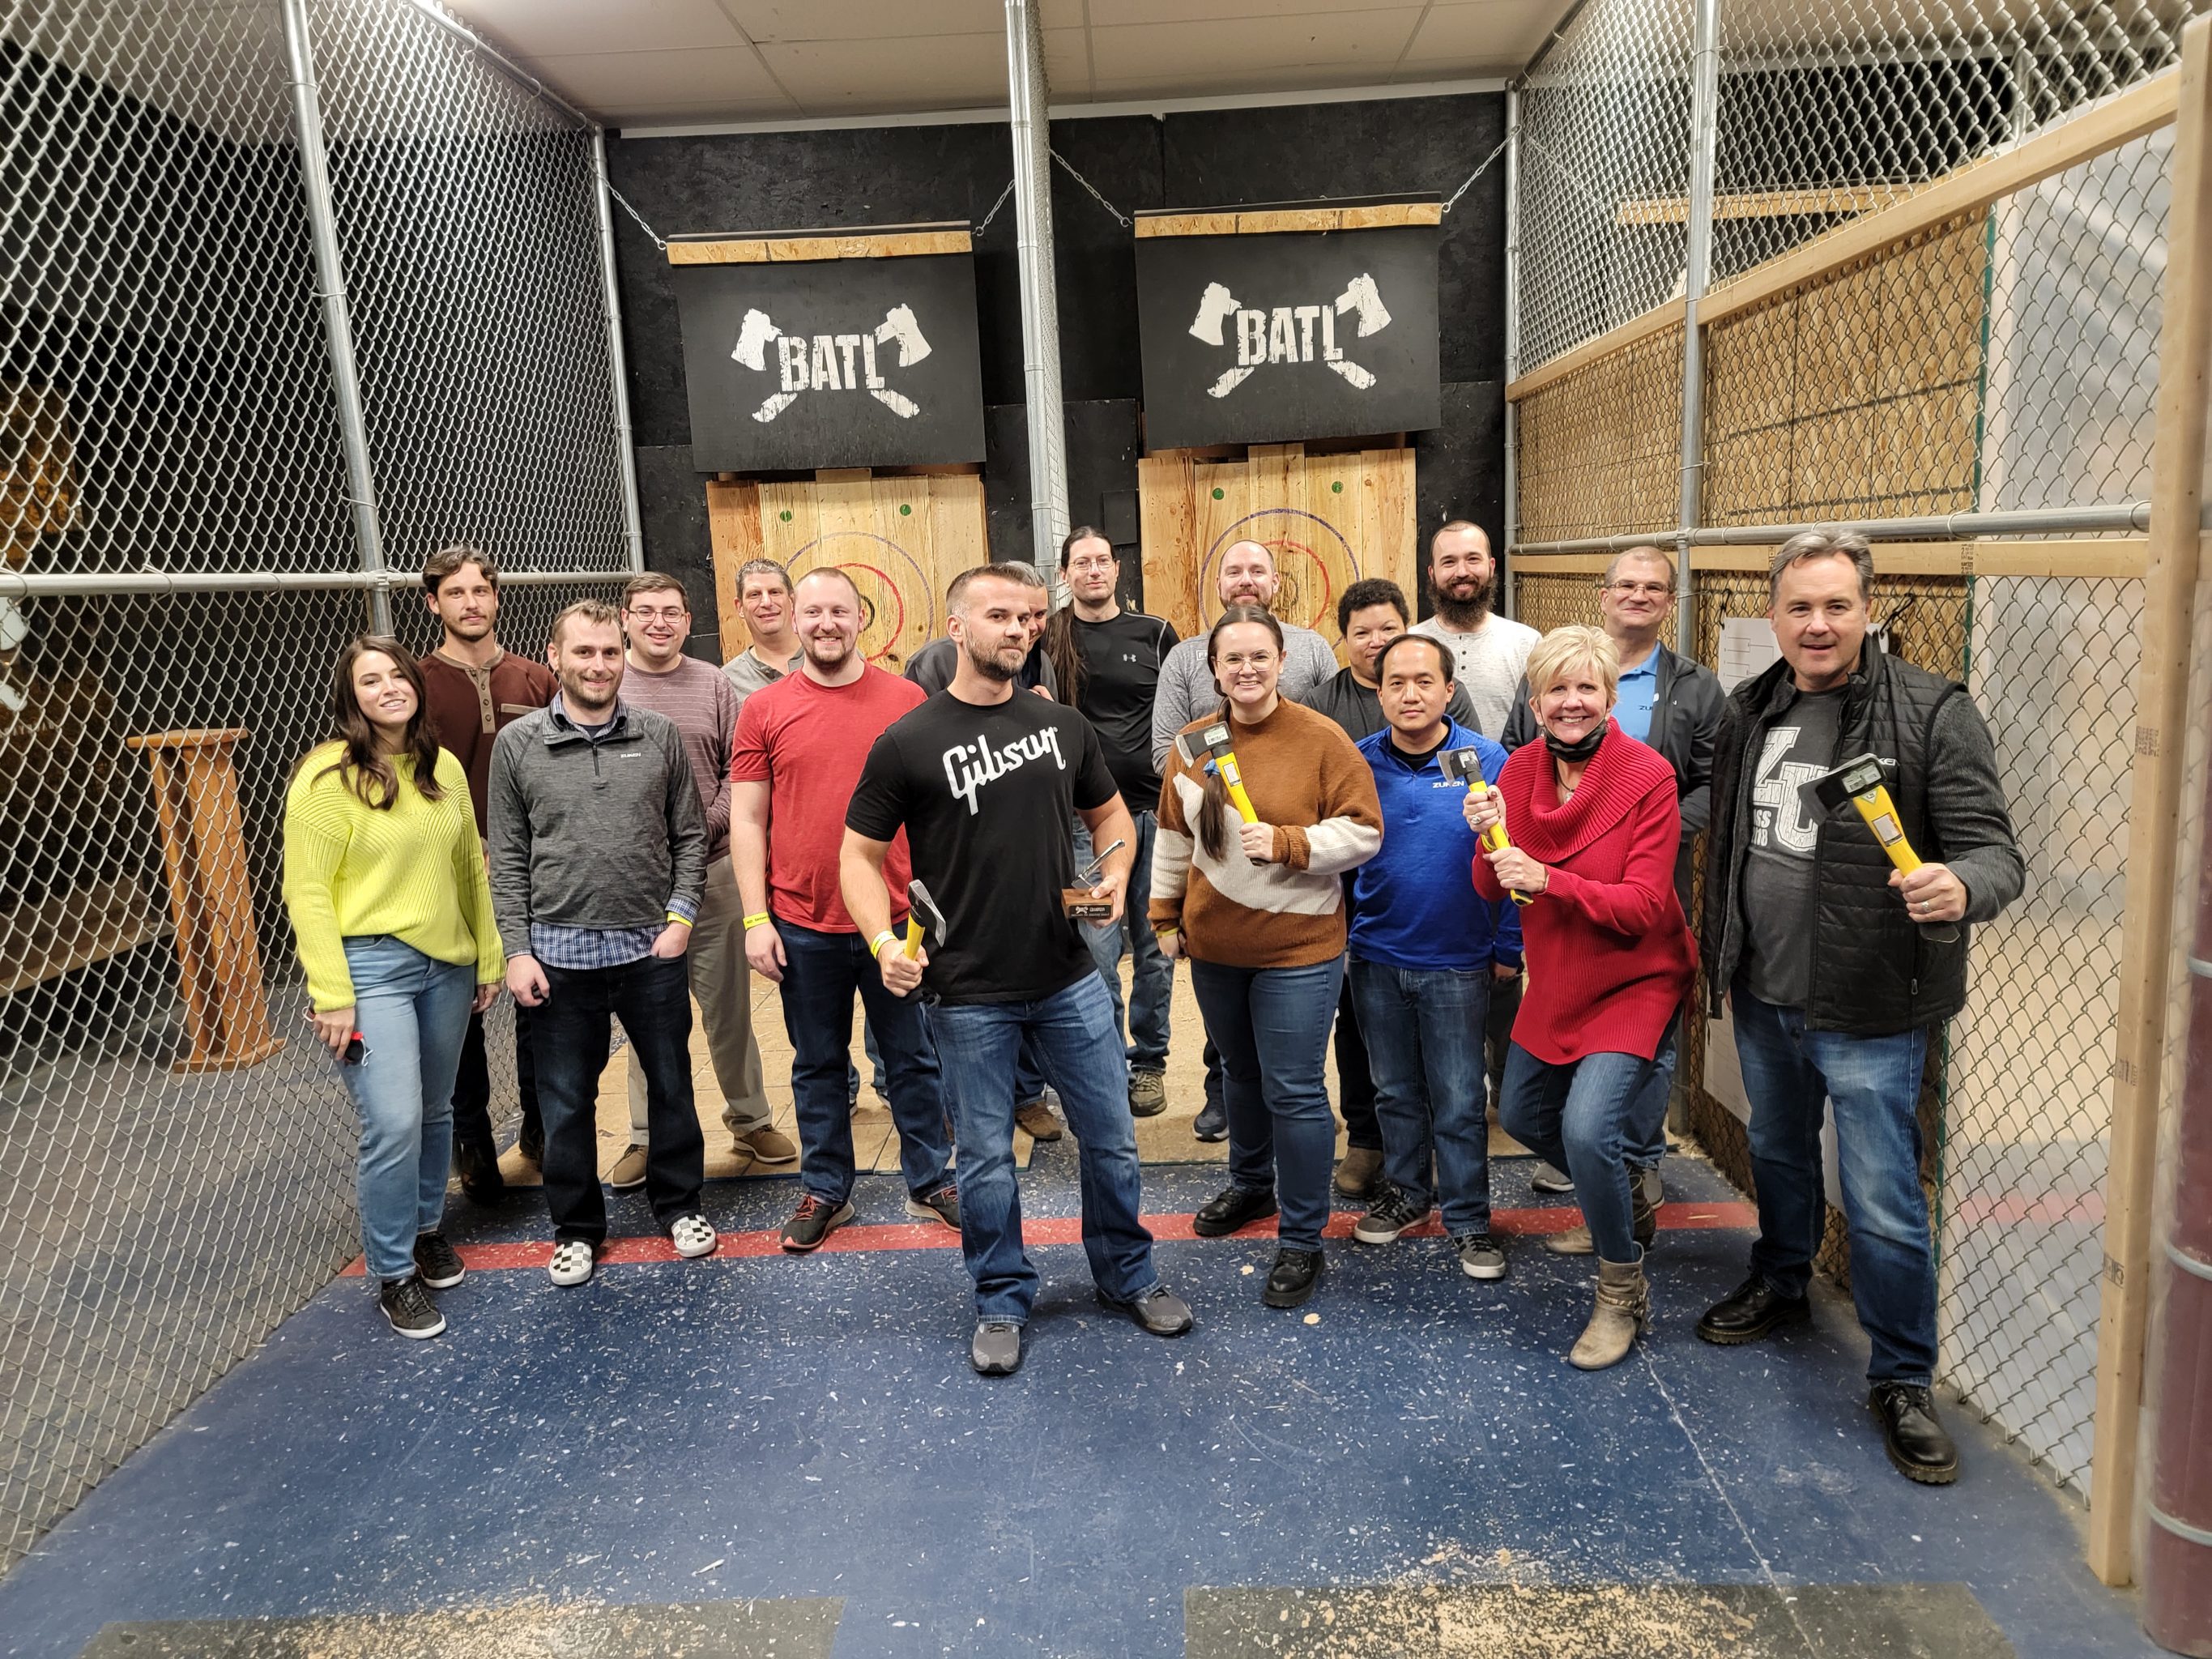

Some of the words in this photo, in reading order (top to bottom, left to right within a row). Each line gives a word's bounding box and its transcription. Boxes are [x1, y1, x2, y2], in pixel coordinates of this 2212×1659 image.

[778, 334, 885, 391] BATL
[1237, 305, 1344, 366] BATL
[943, 727, 1066, 816] Gibson
